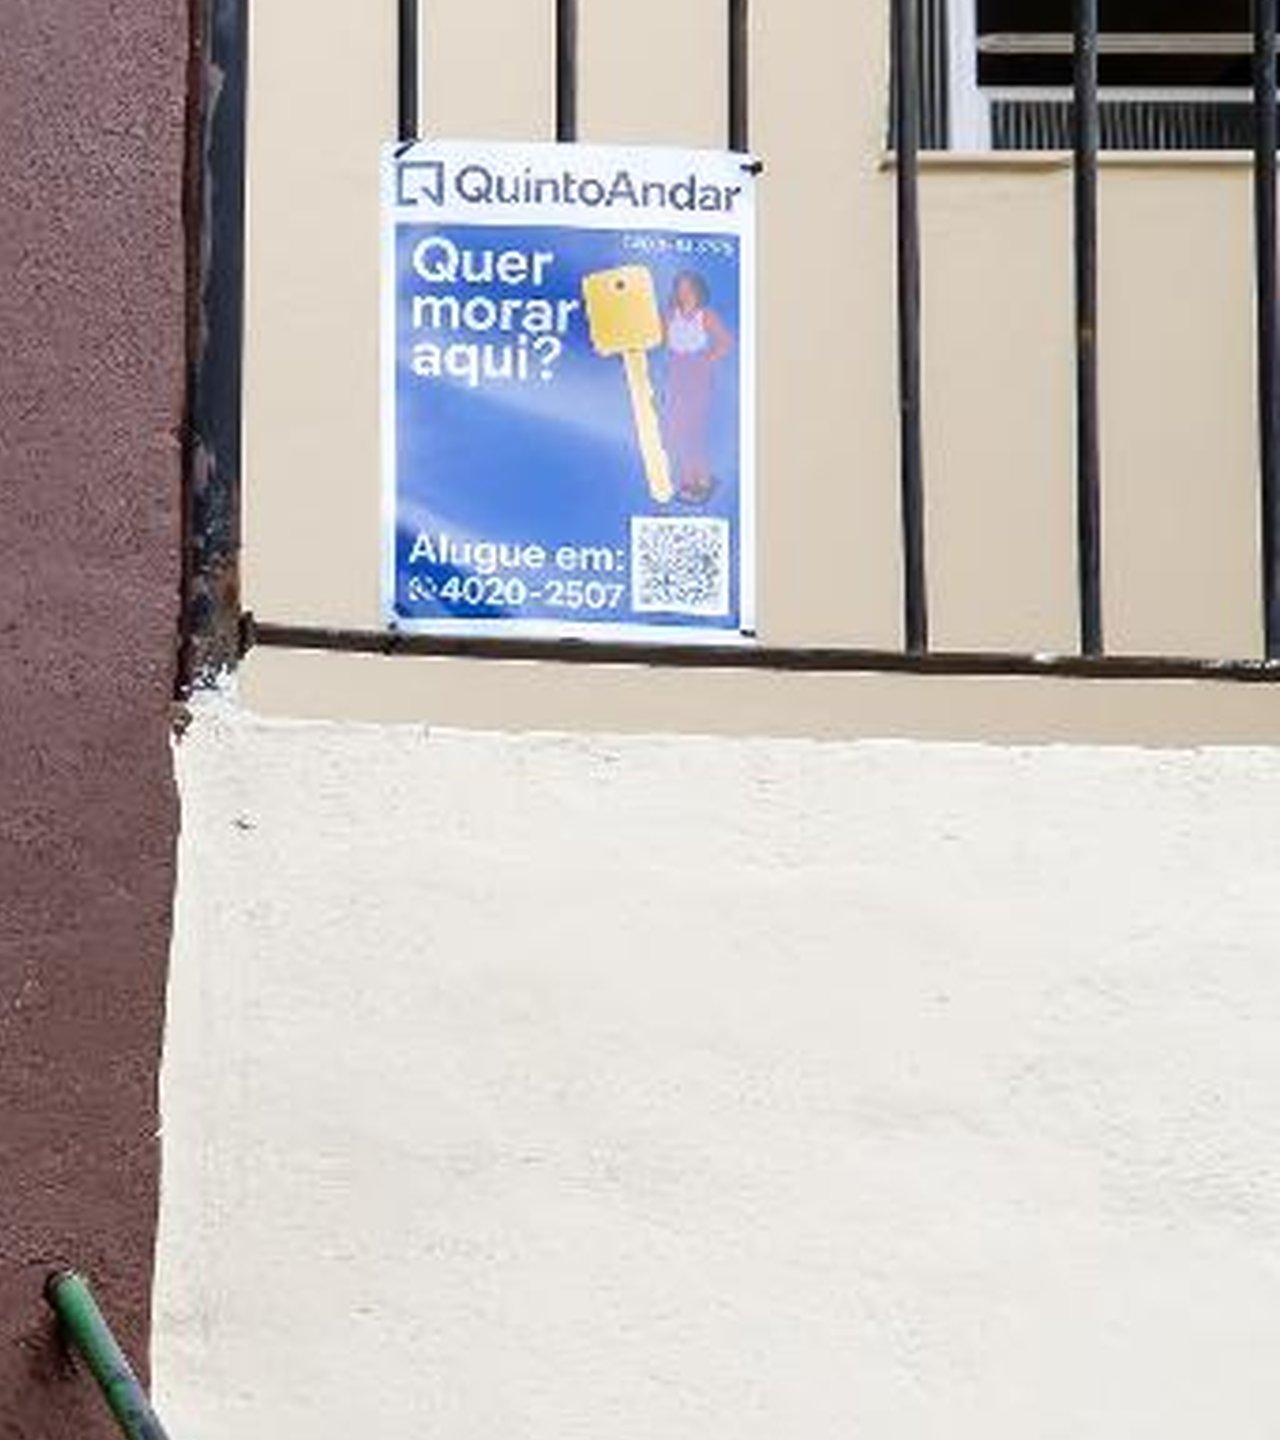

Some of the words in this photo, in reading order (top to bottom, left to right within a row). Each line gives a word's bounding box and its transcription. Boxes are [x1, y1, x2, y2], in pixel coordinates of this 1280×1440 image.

[454, 164, 741, 212] QuintoAndar
[412, 236, 555, 286] Quer
[410, 294, 580, 336] morar
[410, 334, 562, 388] aqui?
[408, 532, 547, 575] Alugue
[554, 542, 626, 572] em:
[440, 575, 626, 609] 4020-2507
